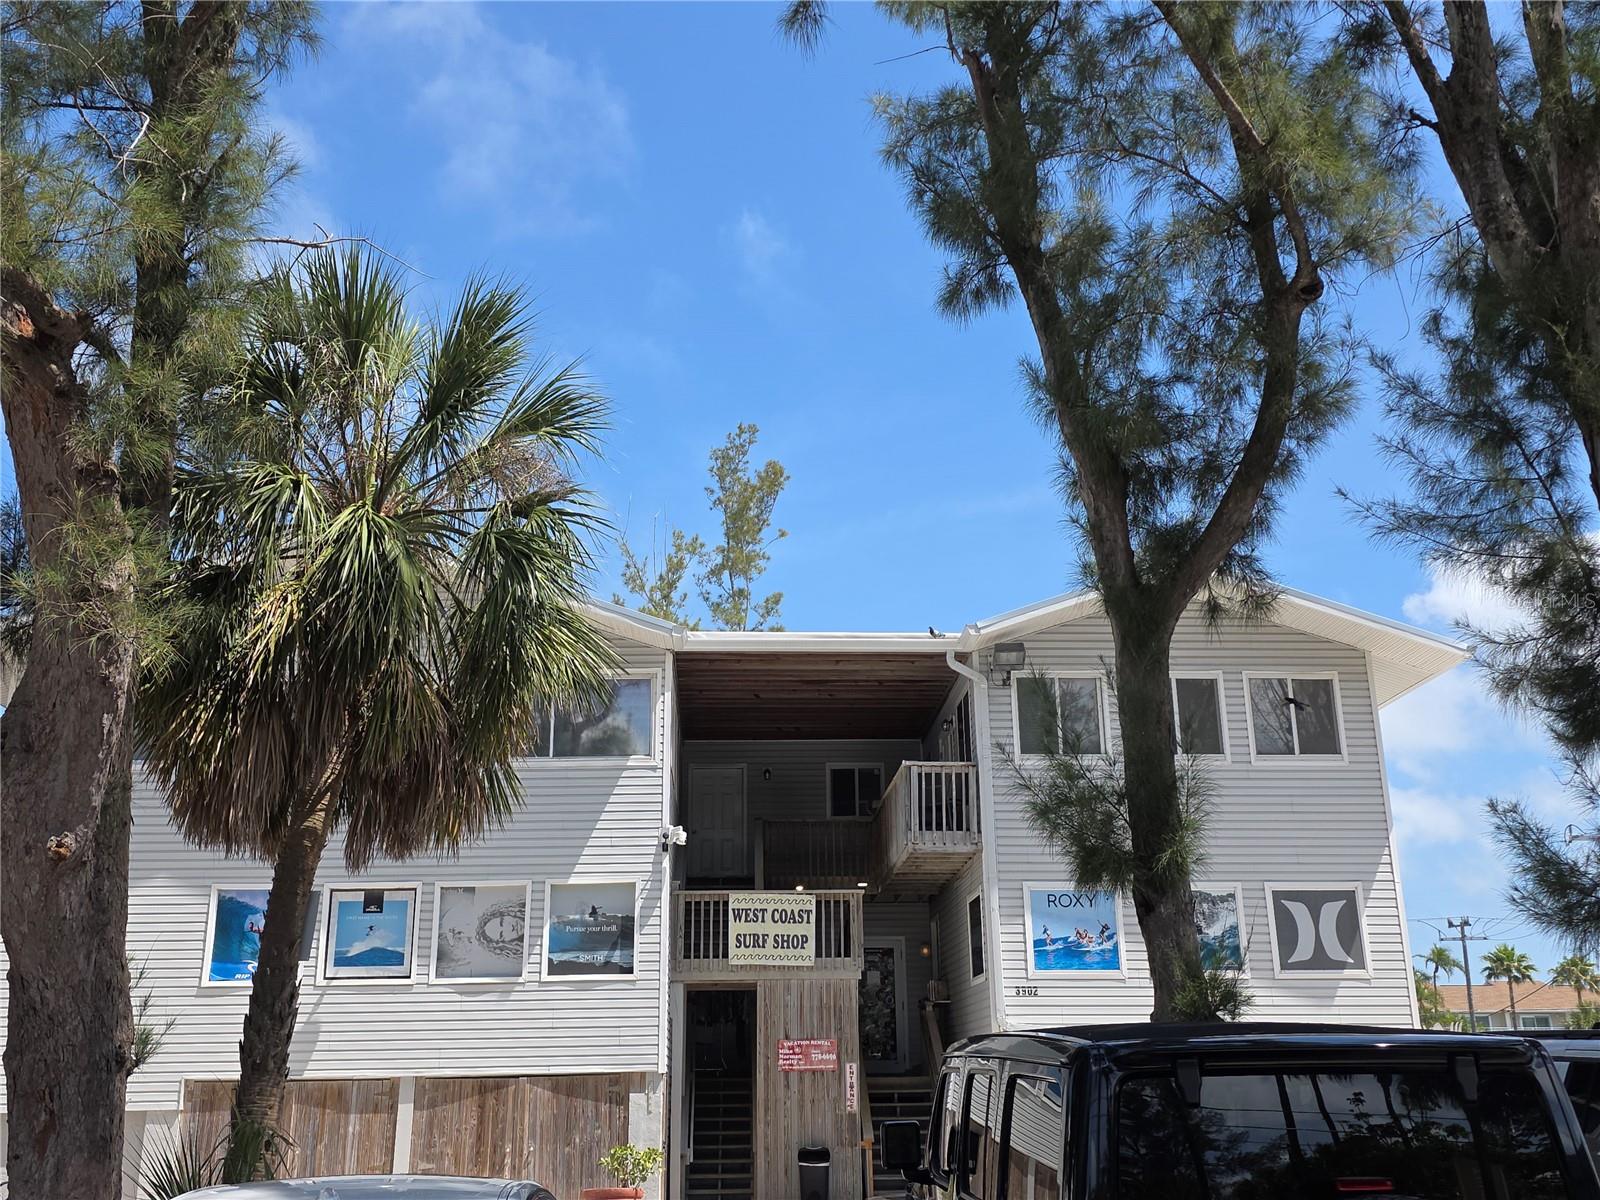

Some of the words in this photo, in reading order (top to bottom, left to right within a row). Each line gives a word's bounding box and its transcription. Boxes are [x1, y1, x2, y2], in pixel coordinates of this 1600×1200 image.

[1047, 893, 1097, 908] ROXY
[731, 908, 768, 923] WEST
[771, 908, 813, 924] COAST
[566, 925, 587, 933] Pursue
[587, 926, 601, 934] your
[735, 933, 769, 949] SURF
[772, 934, 809, 950] SHOP
[1015, 986, 1039, 996] 3902
